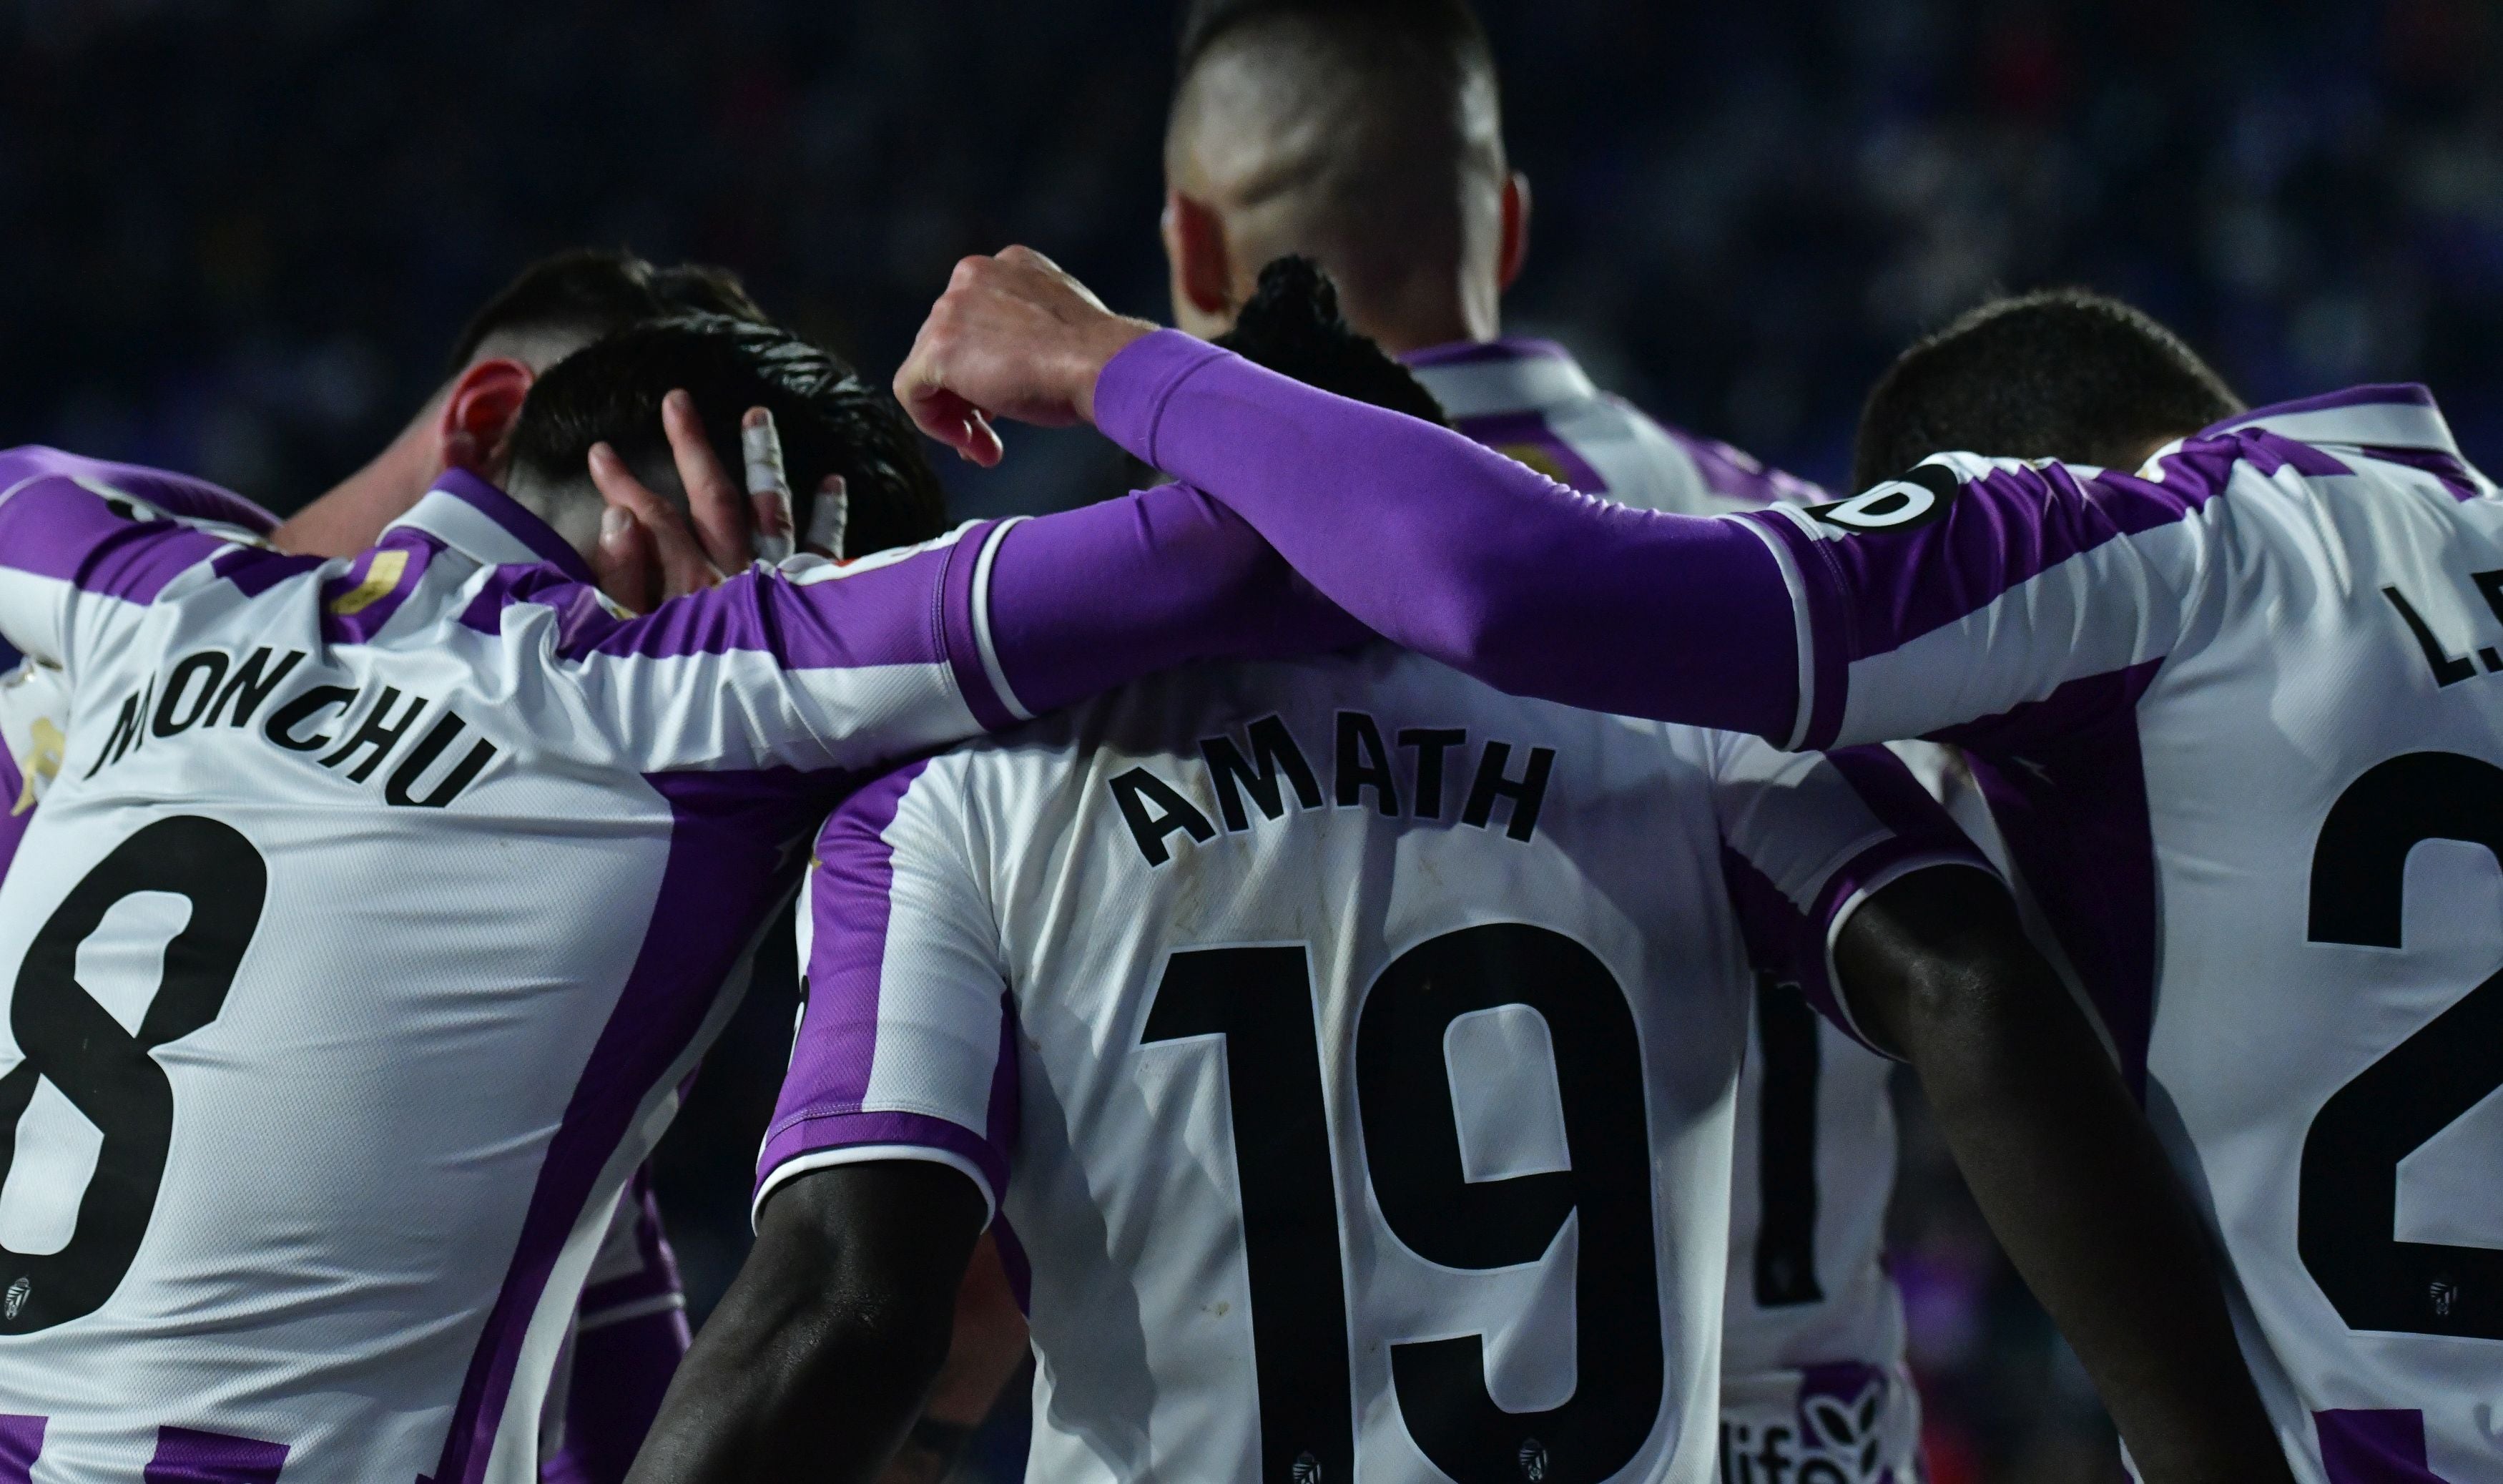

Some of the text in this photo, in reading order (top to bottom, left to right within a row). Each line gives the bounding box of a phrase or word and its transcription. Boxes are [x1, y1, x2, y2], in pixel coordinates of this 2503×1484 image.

[84, 647, 498, 807] MONCHU
[1109, 711, 1555, 868] AMATH
[0, 815, 267, 1336] 8
[1139, 922, 1666, 1484] 19
[2298, 751, 2503, 1340] 2
